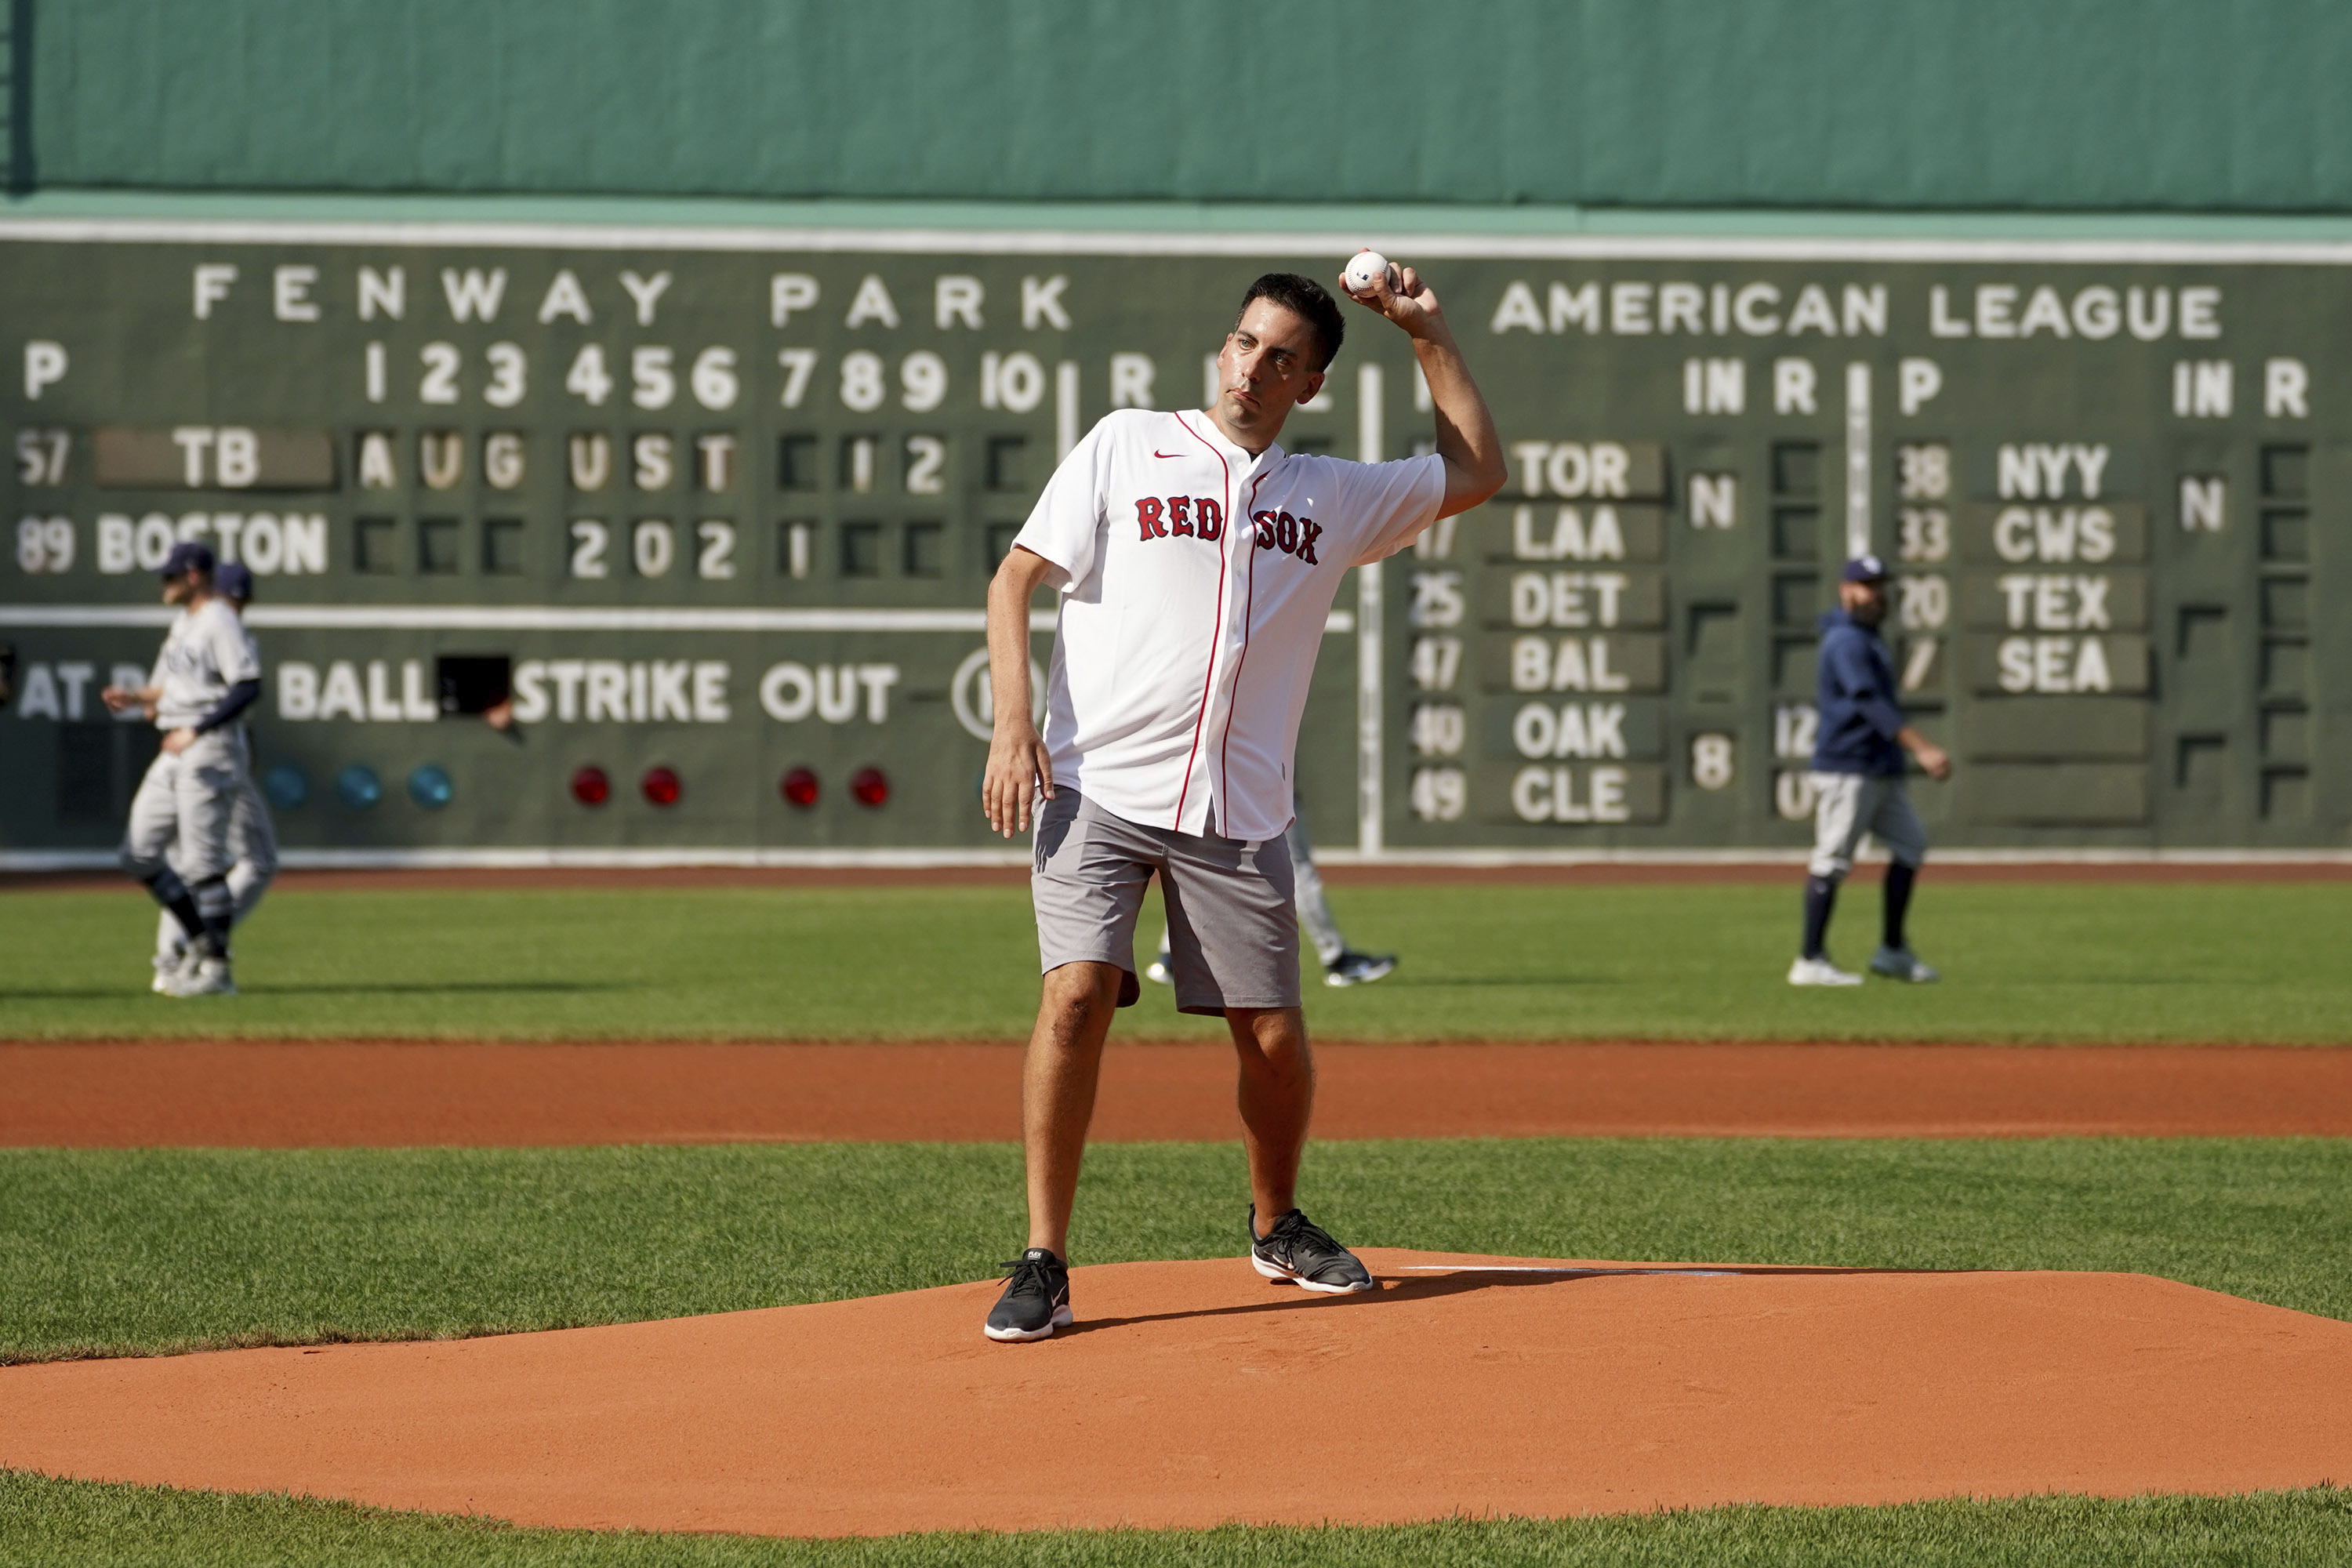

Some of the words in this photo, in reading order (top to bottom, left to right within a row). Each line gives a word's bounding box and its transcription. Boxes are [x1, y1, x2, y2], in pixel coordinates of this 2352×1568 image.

[193, 264, 670, 325] FENWAY
[771, 274, 1069, 330] PARK
[1491, 281, 1887, 336] AMERICAN
[1929, 285, 2220, 341] LEAGUE
[24, 342, 67, 399] P
[366, 343, 386, 402] 1
[419, 343, 459, 404] 2
[485, 343, 526, 407] 3
[566, 344, 612, 405] 4
[632, 347, 675, 410] 5
[691, 347, 738, 410] 6
[779, 349, 816, 408] 7
[840, 351, 884, 412] 8
[901, 352, 947, 412] 9
[981, 353, 1045, 413] 10
[1110, 354, 1154, 410] R
[1684, 359, 1745, 414] IN
[1774, 358, 1816, 414] R
[1900, 358, 1942, 416] P
[2174, 361, 2233, 416] IN
[2265, 359, 2308, 418] R
[16, 427, 71, 487] 57
[172, 427, 260, 487] TB
[1515, 441, 1629, 496] TOR
[1899, 446, 1951, 499] 38
[1998, 445, 2108, 498] NYY
[1690, 476, 1735, 528] N
[2181, 479, 2224, 531] N
[16, 515, 76, 574] 89
[1134, 495, 1223, 542] RED
[1254, 509, 1323, 566] SOX
[1514, 506, 1623, 559] LAA
[1899, 509, 1951, 561] 33
[1994, 507, 2115, 561] CWS
[1512, 572, 1624, 626] DET
[1900, 575, 1949, 628] 20
[2001, 575, 2108, 630] TEX
[17, 662, 96, 720] AT
[278, 661, 438, 722] BALL
[513, 660, 729, 723] STRIKE
[1411, 637, 1461, 689] 47
[1512, 637, 1627, 691] BAL
[1999, 638, 2110, 692] SEA
[760, 663, 899, 724] OUT
[1410, 704, 1465, 756] 40
[1513, 703, 1624, 757] OAK
[1774, 706, 1820, 758] 12
[1693, 736, 1732, 788] 8
[1410, 768, 1466, 822] 49
[1512, 767, 1628, 822] CLE
